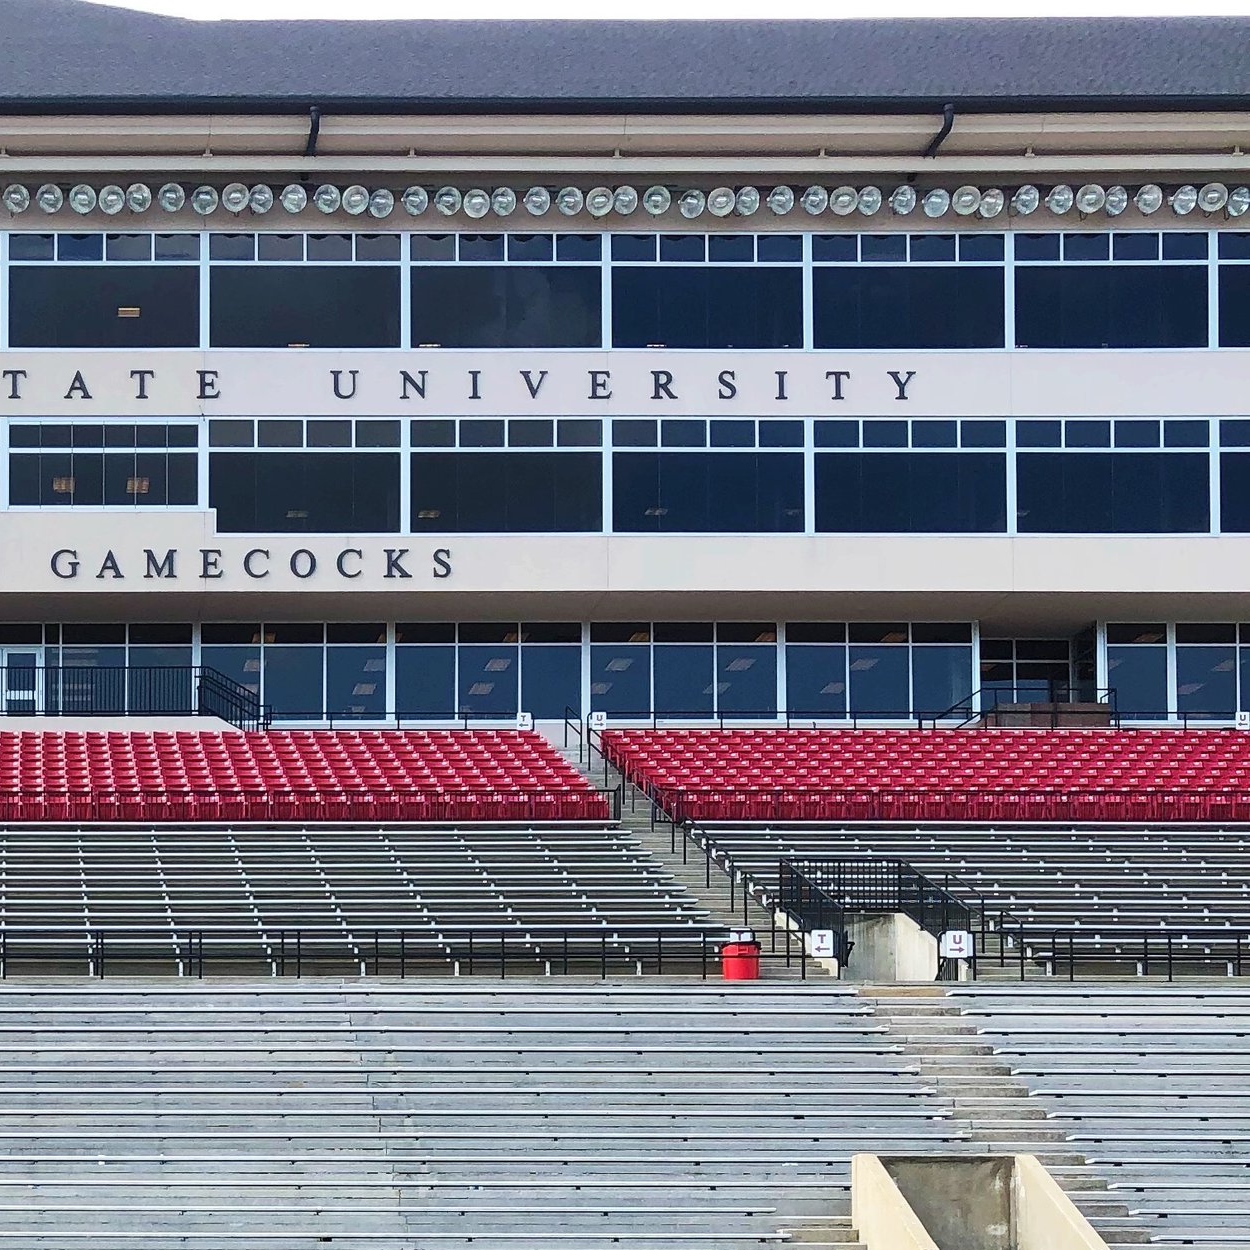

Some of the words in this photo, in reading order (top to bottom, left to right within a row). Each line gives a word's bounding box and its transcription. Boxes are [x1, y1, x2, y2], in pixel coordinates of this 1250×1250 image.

[329, 370, 917, 401] UNIVERSITY
[50, 548, 452, 580] GAMECOCKS
[520, 714, 527, 722] T
[596, 714, 604, 722] U
[1239, 713, 1248, 722] U
[817, 933, 826, 945] T
[952, 934, 962, 945] U
